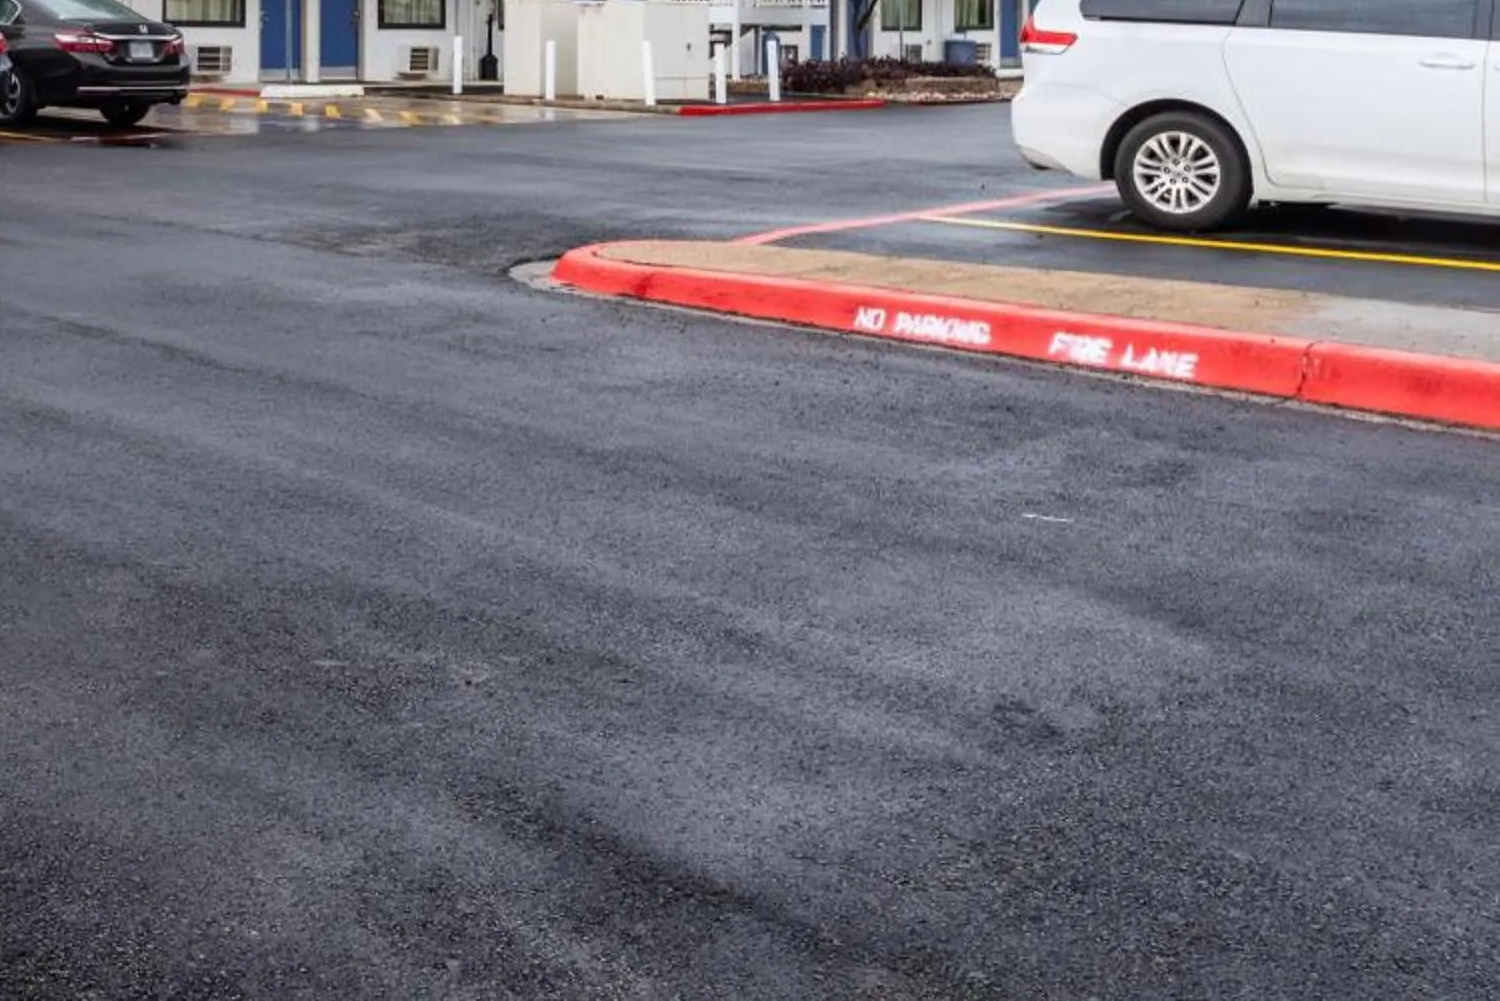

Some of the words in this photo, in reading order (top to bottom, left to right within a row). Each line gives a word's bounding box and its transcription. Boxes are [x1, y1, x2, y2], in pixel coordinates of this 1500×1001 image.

[854, 306, 886, 330] NO
[894, 311, 992, 344] PARKING
[1119, 342, 1198, 378] LANE
